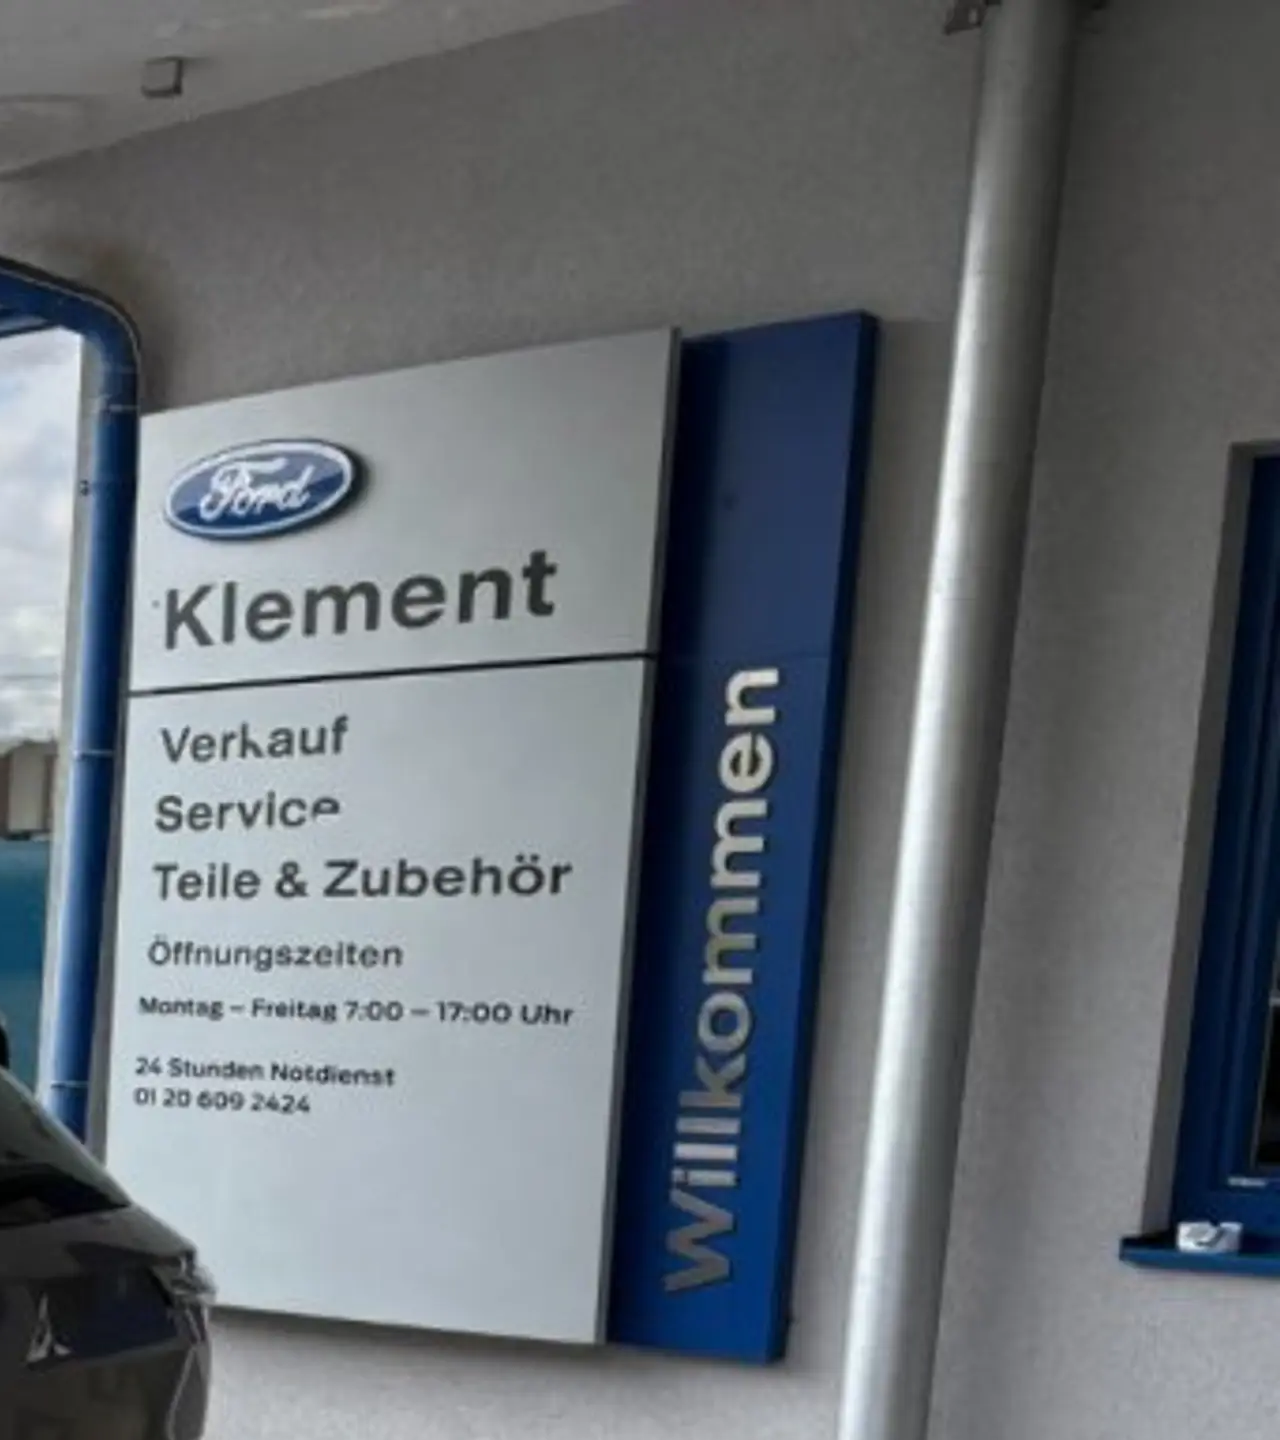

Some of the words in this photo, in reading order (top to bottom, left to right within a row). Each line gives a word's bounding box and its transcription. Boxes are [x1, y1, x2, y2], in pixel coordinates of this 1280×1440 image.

[199, 454, 317, 522] Ford
[165, 549, 558, 649] Klement
[159, 713, 348, 764] Verkauf
[154, 789, 342, 833] Service
[151, 861, 261, 900] Teile
[275, 860, 309, 899] &
[323, 853, 574, 897] Zubehör
[147, 934, 404, 972] Öffnungszeiten
[663, 667, 780, 1291] Willkommen
[138, 996, 224, 1021] Montag
[251, 997, 337, 1023] Freitag
[343, 1000, 403, 1022] 7:00
[437, 1001, 513, 1023] 17:00
[520, 1002, 574, 1025] Uhr
[134, 1057, 162, 1077] 24
[167, 1057, 264, 1081] Stunden
[270, 1061, 395, 1087] Notdienst
